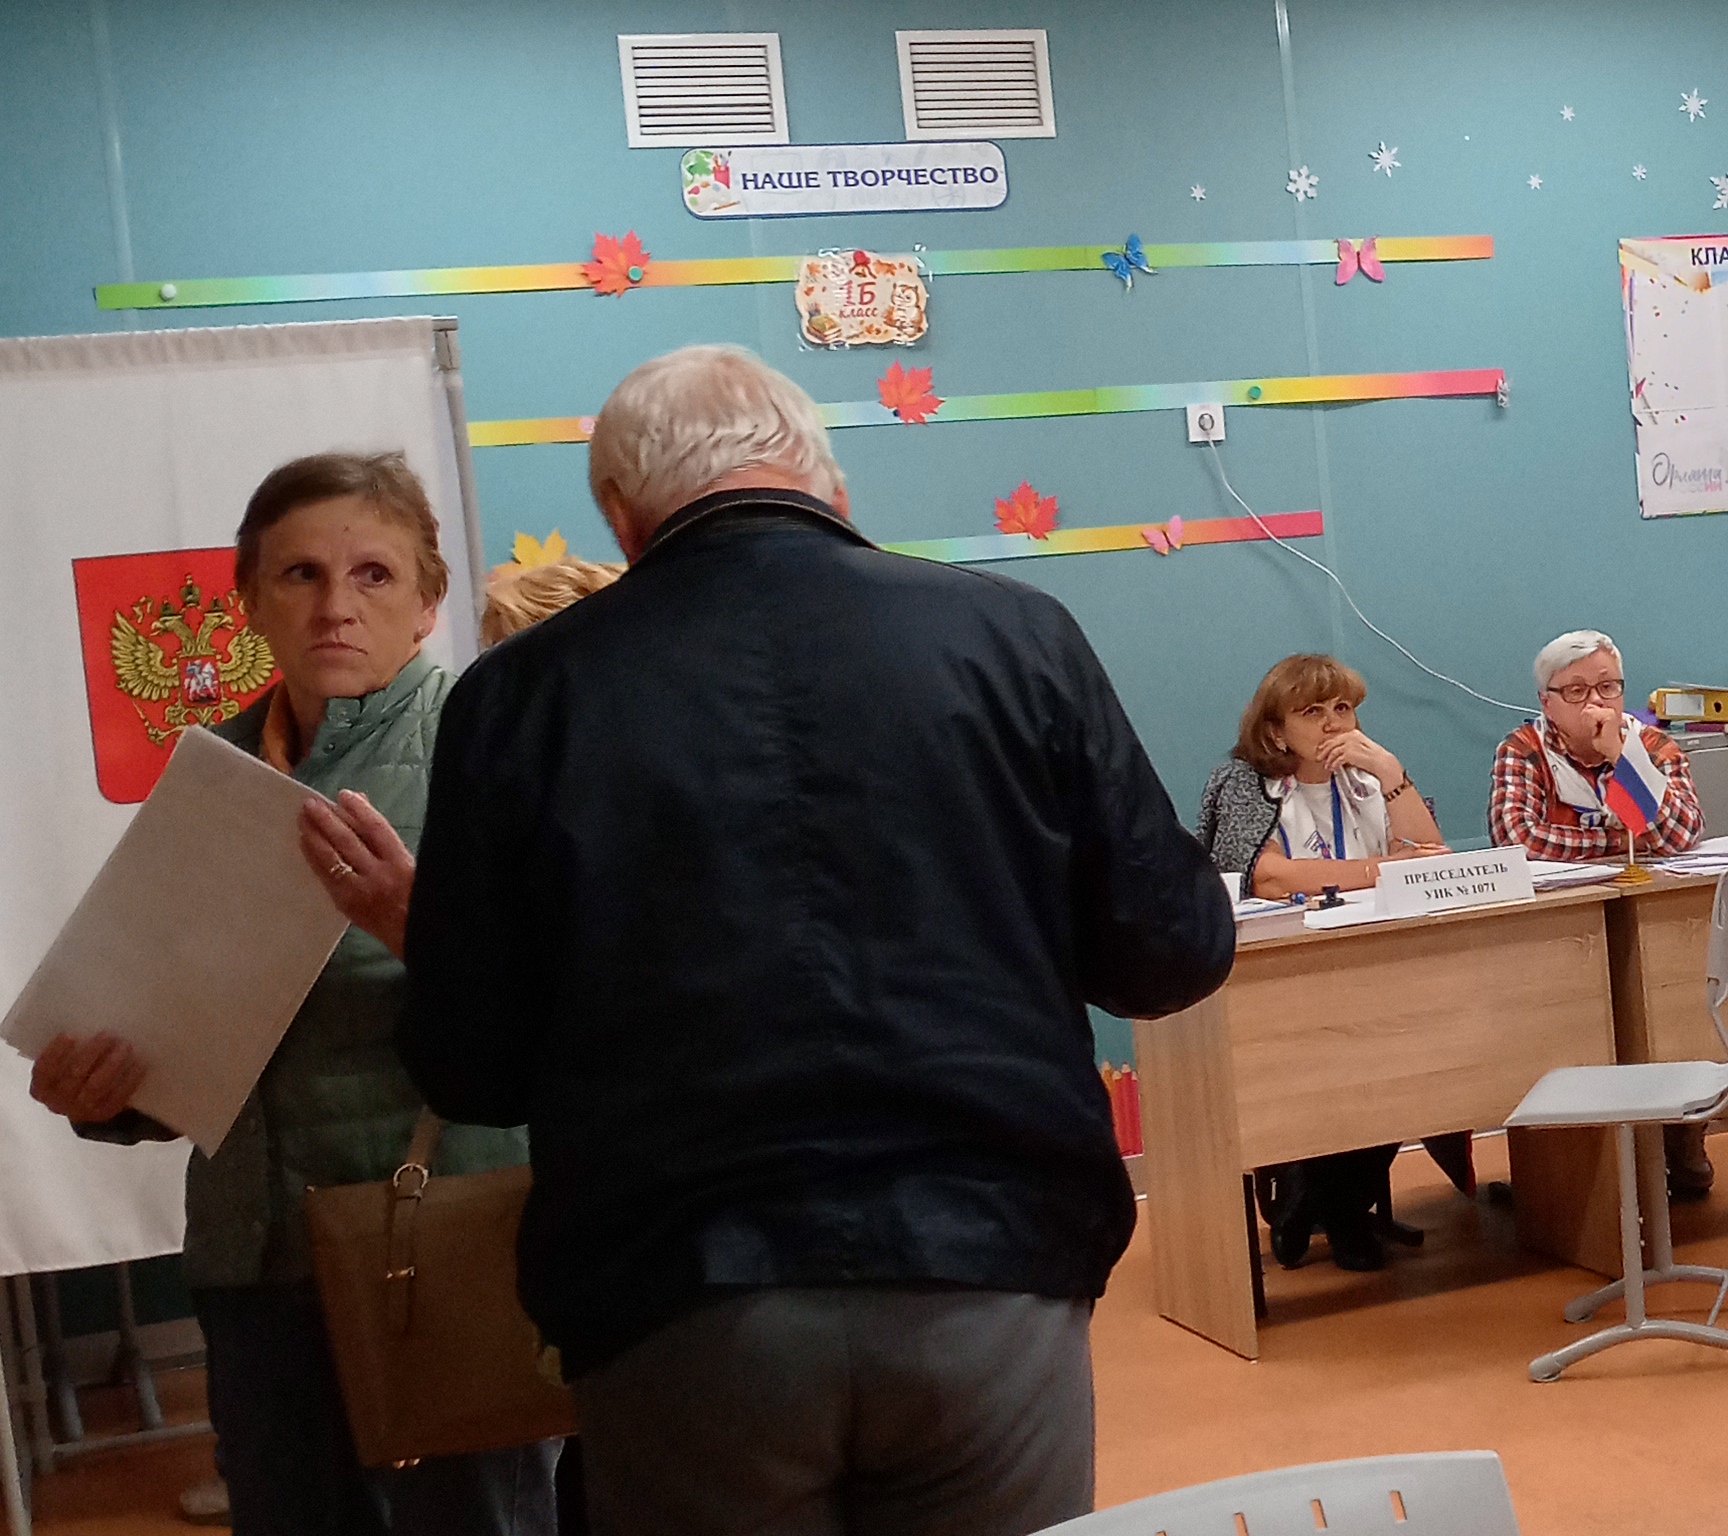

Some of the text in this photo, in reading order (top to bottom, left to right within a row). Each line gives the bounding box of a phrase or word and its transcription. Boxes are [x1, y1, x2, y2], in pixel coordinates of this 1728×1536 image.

[741, 166, 999, 190] НАШЕ ТВОРЧЕСТВО
[839, 307, 878, 319] класс
[1404, 862, 1509, 885] ПРЕДСЕДАТЕЛЬ
[1472, 882, 1497, 895] 1071
